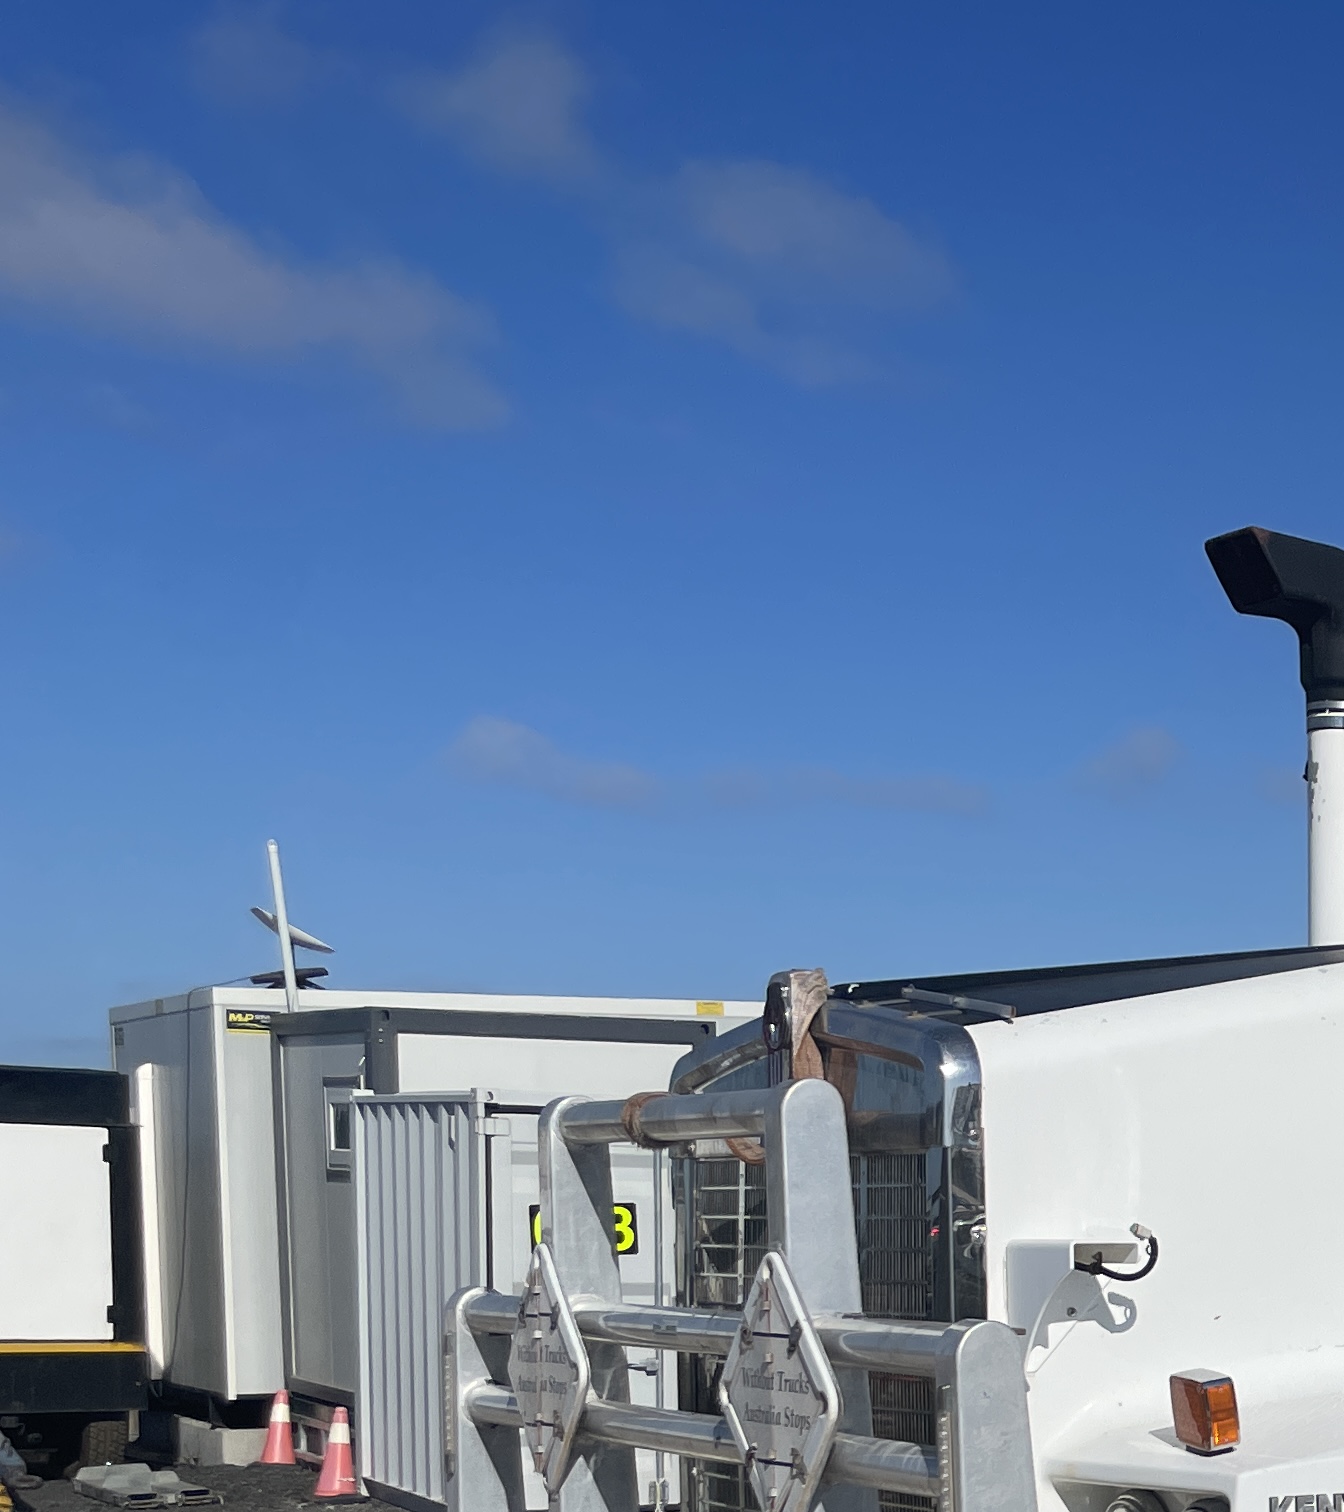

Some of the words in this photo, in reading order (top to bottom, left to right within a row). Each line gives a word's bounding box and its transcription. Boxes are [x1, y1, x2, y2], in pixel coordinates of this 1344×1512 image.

[544, 1345, 567, 1366] Trucks
[549, 1376, 567, 1396] Stops
[741, 1366, 774, 1391] Without
[777, 1370, 810, 1394] Trucks
[743, 1401, 781, 1426] Australia
[784, 1406, 811, 1437] Stops
